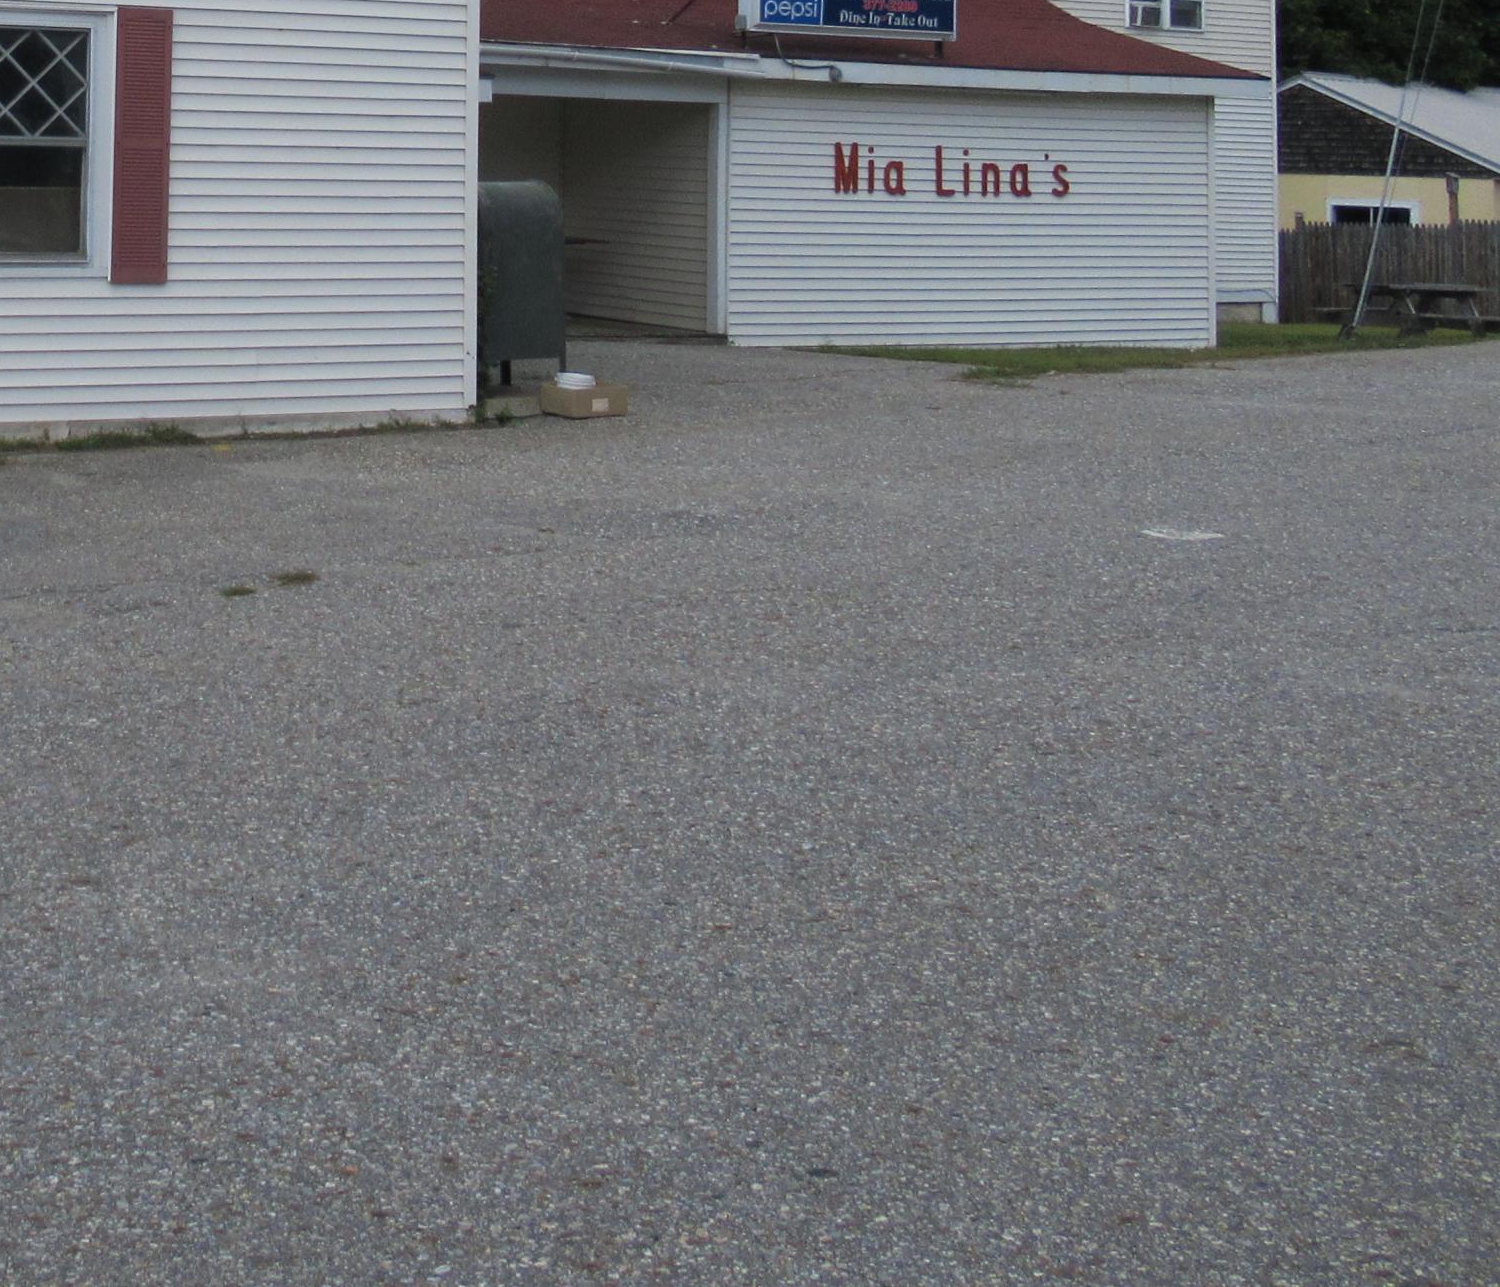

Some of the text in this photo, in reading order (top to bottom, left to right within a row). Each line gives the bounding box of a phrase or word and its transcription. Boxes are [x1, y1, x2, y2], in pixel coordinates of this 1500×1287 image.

[840, 9, 867, 26] Dine
[917, 15, 939, 28] Out
[834, 142, 1070, 197] Mia Lina's
